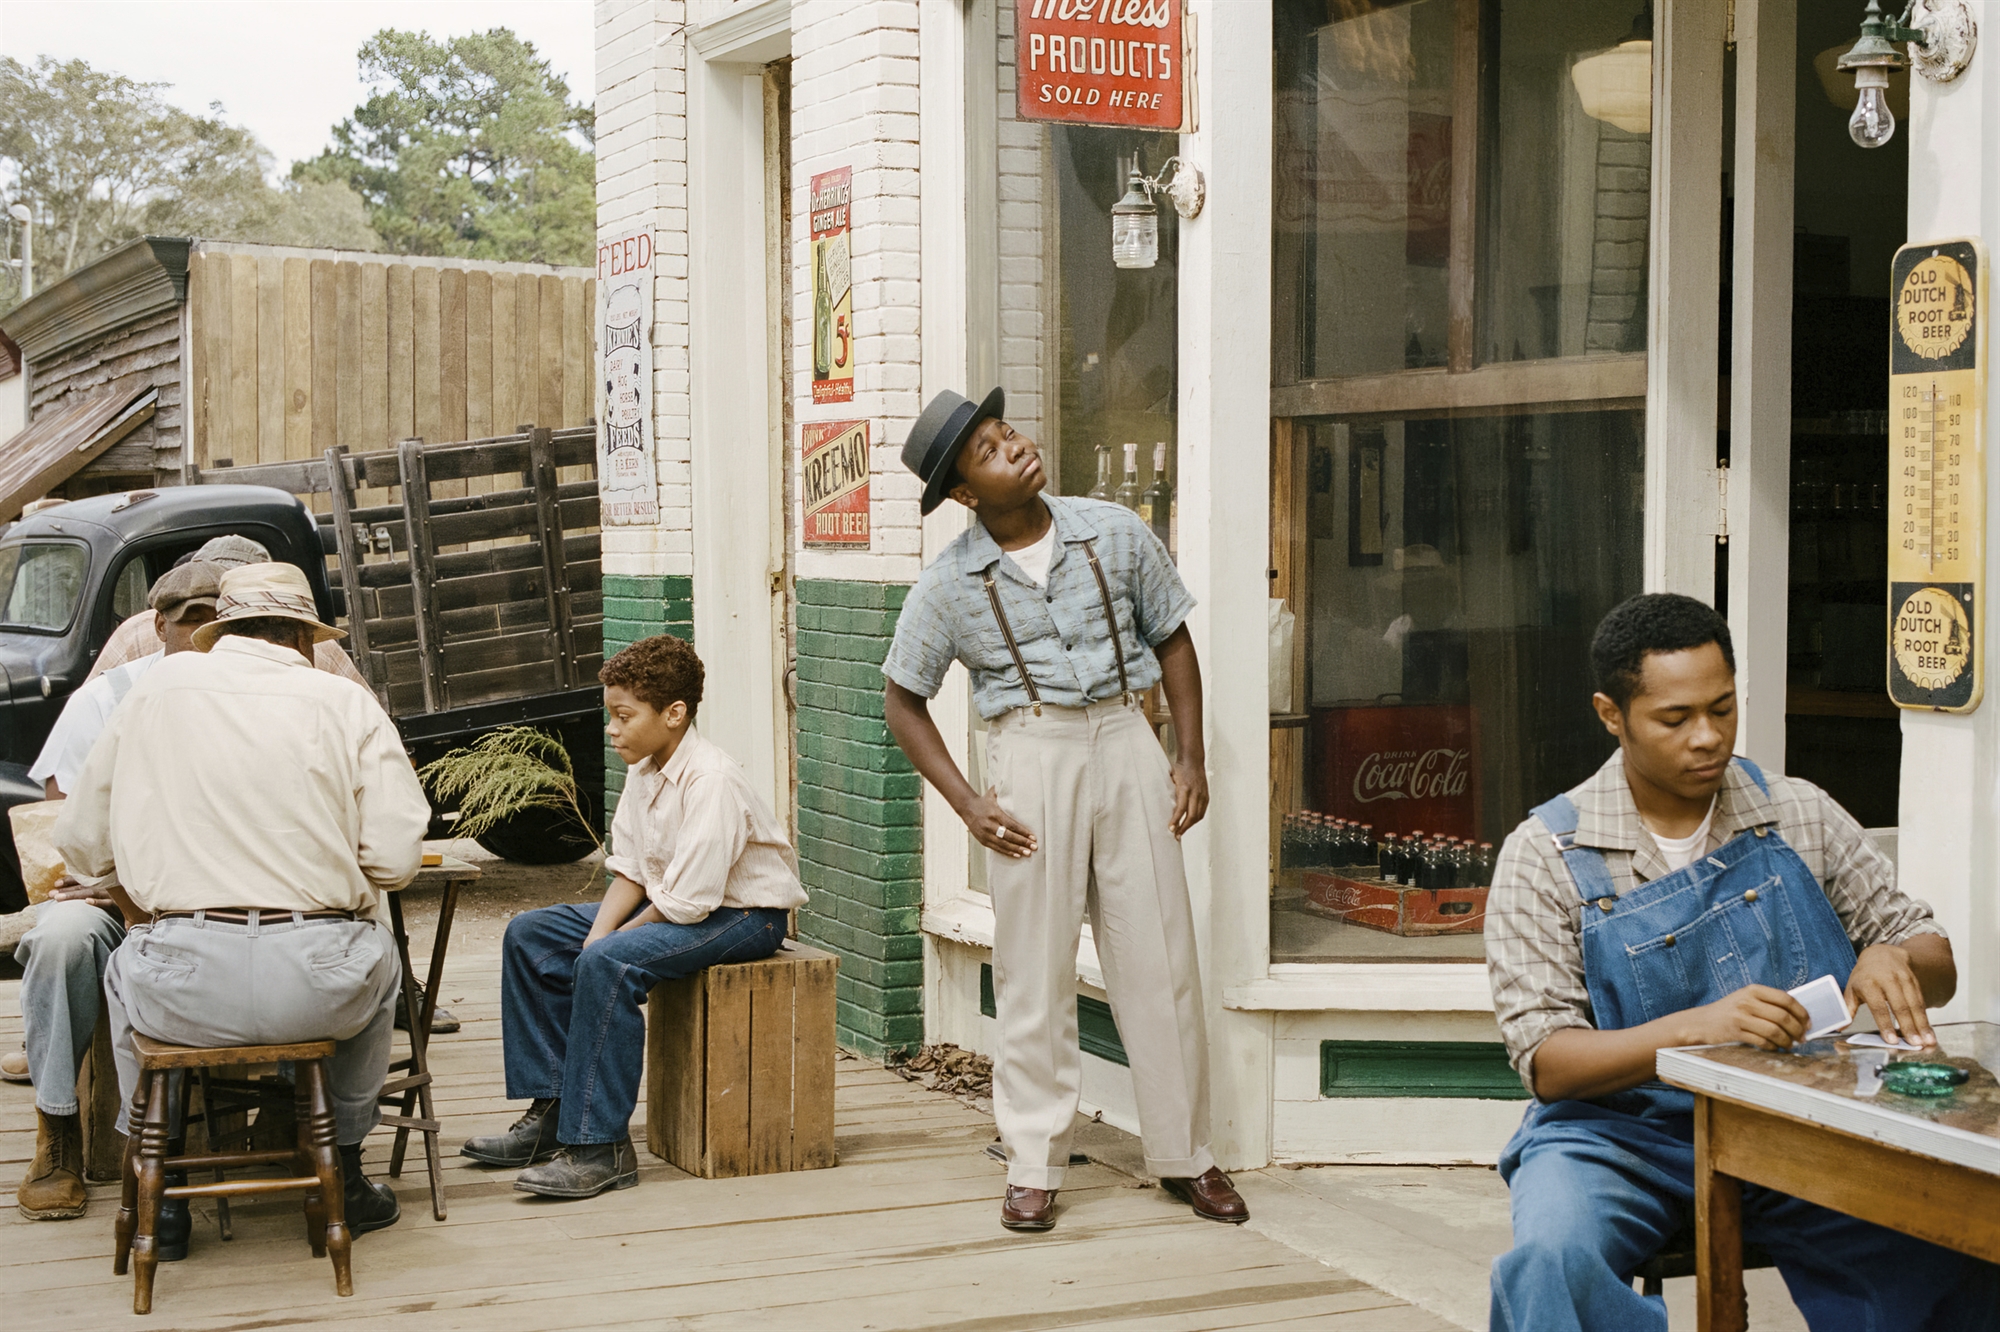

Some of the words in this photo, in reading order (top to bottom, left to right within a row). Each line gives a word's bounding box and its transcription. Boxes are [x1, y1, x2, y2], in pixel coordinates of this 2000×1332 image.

[1030, 34, 1171, 79] PRODUCTS
[1039, 84, 1100, 106] SOLD
[1109, 90, 1163, 110] HERE
[814, 211, 834, 233] GINGER
[835, 207, 846, 228] ALE
[598, 233, 652, 280] FEED
[1909, 270, 1937, 285] OLD
[1904, 286, 1946, 304] DUTCH
[1909, 309, 1943, 324] ROOT
[1922, 325, 1952, 339] BEER
[1903, 386, 1918, 398] 120
[1949, 394, 1961, 406] 110
[1903, 407, 1918, 419] 100
[1949, 414, 1961, 426] 90
[609, 420, 641, 450] FEEDS
[1904, 427, 1916, 438] 80
[1949, 434, 1960, 446] 70
[1904, 446, 1916, 458] 60
[1949, 454, 1960, 466] 50
[803, 431, 866, 510] KREEMO
[1903, 466, 1915, 477] 40
[1948, 474, 1960, 486] 30
[1903, 486, 1915, 497] 20
[1949, 494, 1959, 505] 10
[1906, 504, 1913, 515] 0
[816, 512, 840, 536] ROOT
[842, 512, 868, 536] BEER
[1949, 512, 1959, 524] 10
[1903, 522, 1914, 533] 20
[1947, 531, 1959, 543] 30
[1902, 539, 1914, 550] 40
[1947, 549, 1959, 560] 50
[1906, 600, 1932, 614] OLD
[1900, 617, 1942, 634] DUTCH
[1904, 639, 1939, 653] ROOT
[1918, 656, 1947, 670] BEER
[1383, 750, 1418, 760] DRINK
[1353, 748, 1469, 803] Coca-Cola
